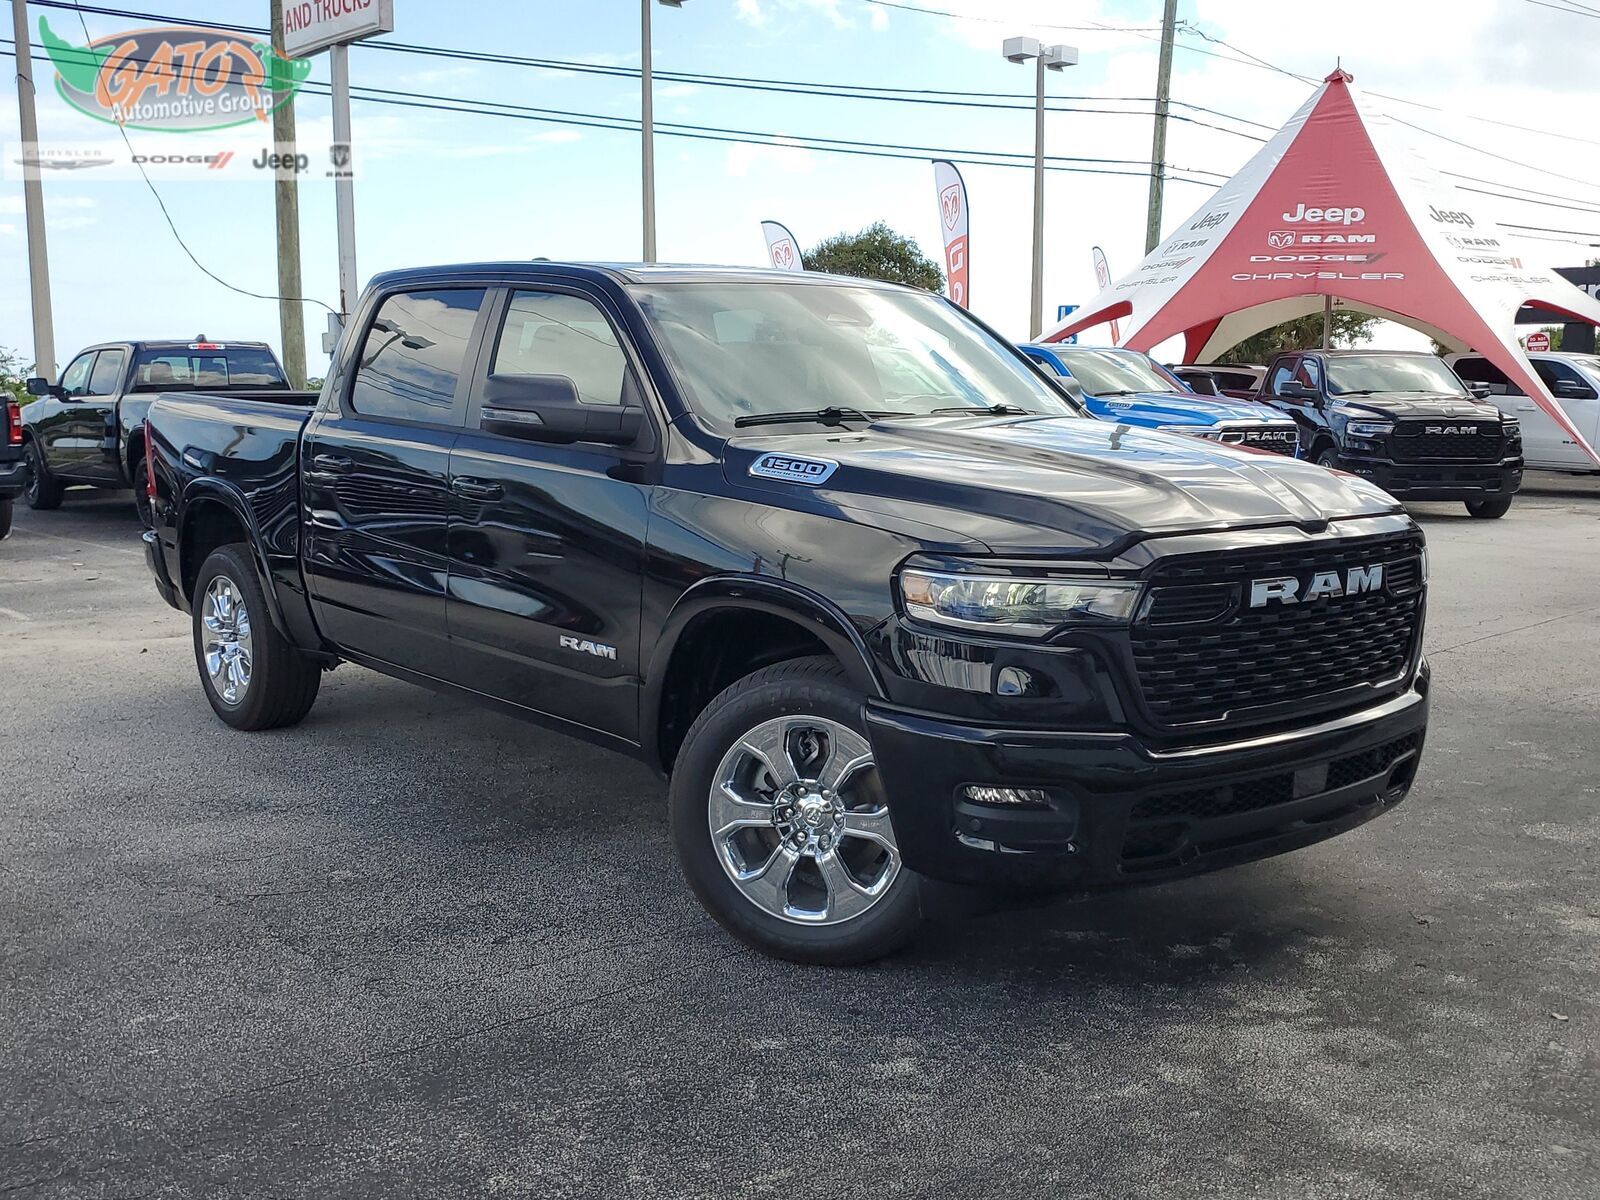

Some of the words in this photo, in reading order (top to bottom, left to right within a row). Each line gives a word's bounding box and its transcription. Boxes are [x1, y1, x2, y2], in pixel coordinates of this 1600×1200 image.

[285, 2, 312, 34] AND
[1190, 211, 1229, 230] Jeep
[1283, 203, 1365, 225] Jeep
[1429, 205, 1475, 228] Jeep
[1178, 239, 1209, 250] RAM
[1302, 234, 1376, 243] RAM
[1461, 237, 1500, 246] RAM
[1232, 272, 1406, 281] CHRYSLER
[1470, 275, 1552, 284] CHRYSLER
[1246, 431, 1286, 441] RAM
[1425, 426, 1478, 435] RAM
[766, 458, 824, 475] 1500
[1250, 563, 1383, 608] RAM
[560, 634, 617, 661] RAM
